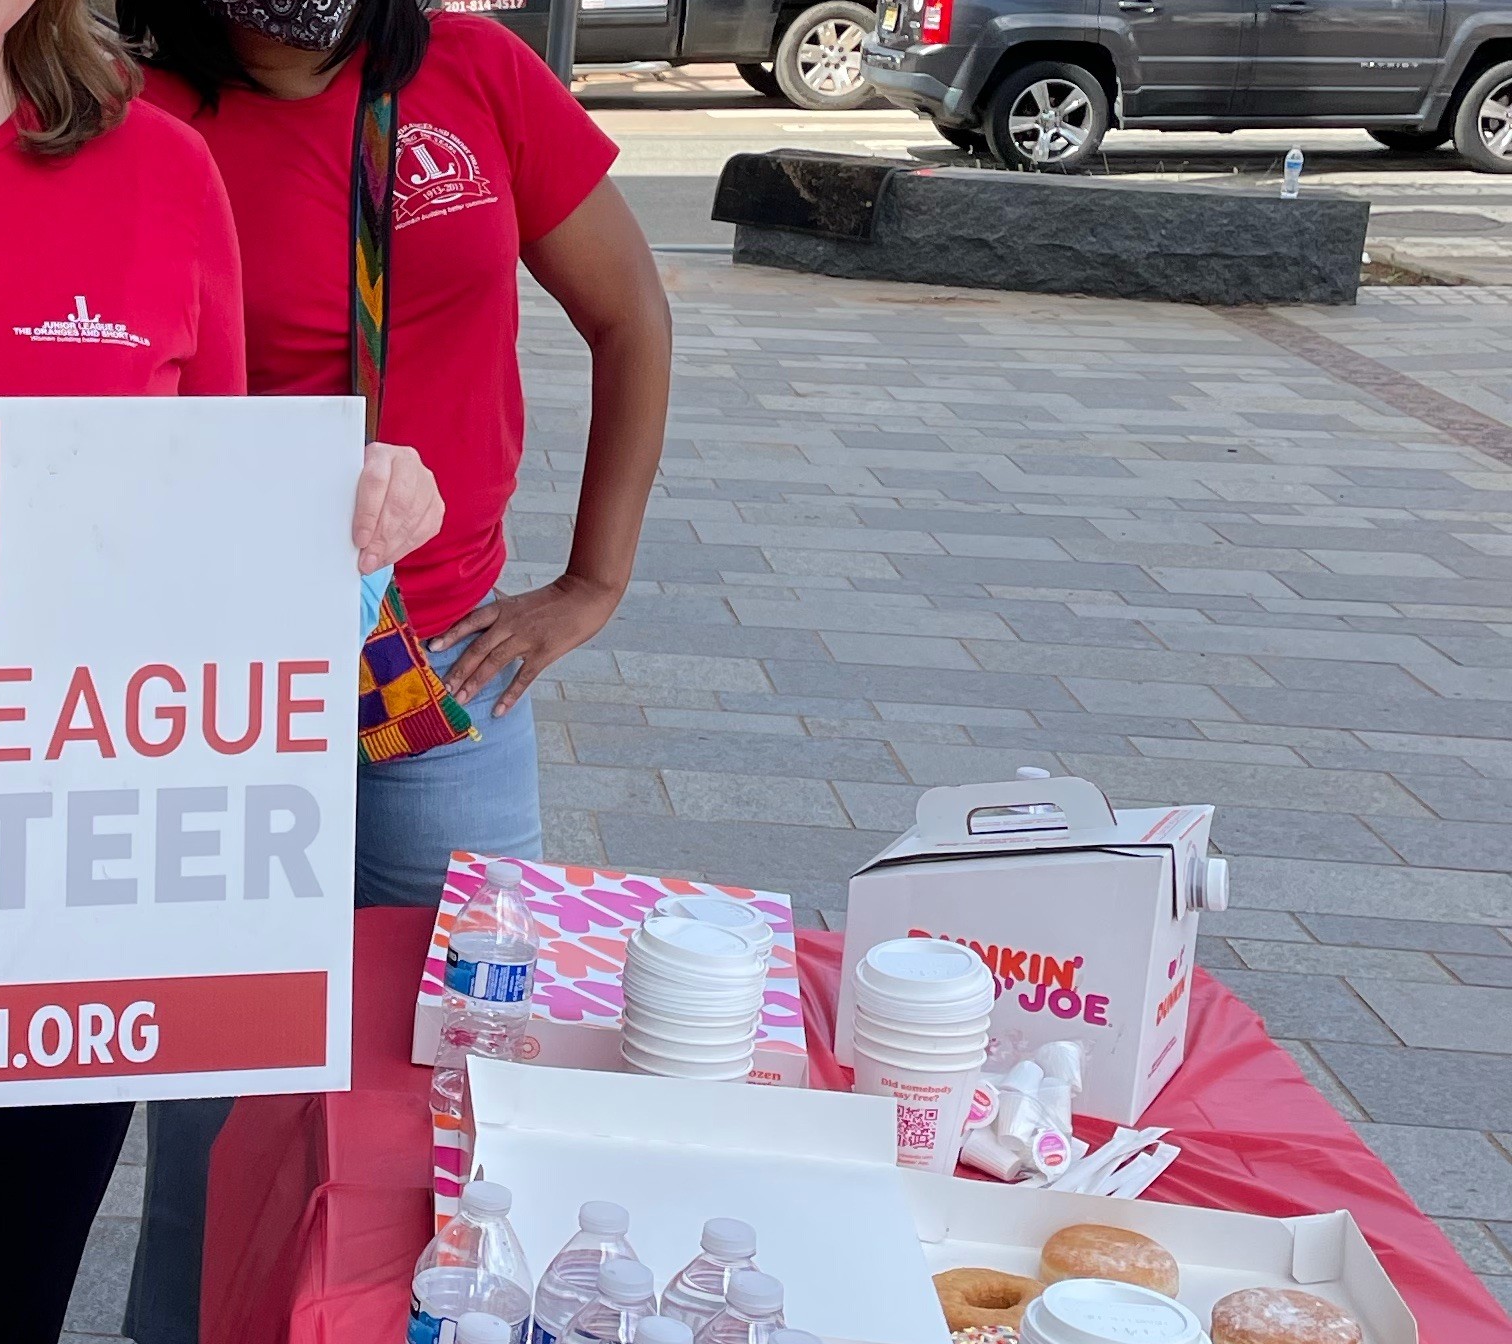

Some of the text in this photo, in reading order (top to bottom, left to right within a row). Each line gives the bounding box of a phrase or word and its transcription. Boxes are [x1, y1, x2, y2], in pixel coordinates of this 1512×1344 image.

[13, 327, 31, 335] THE
[908, 929, 1084, 990] NKIN'
[748, 1070, 781, 1081] ozen
[881, 1078, 953, 1094] Did somebody
[893, 1092, 940, 1102] say free?
